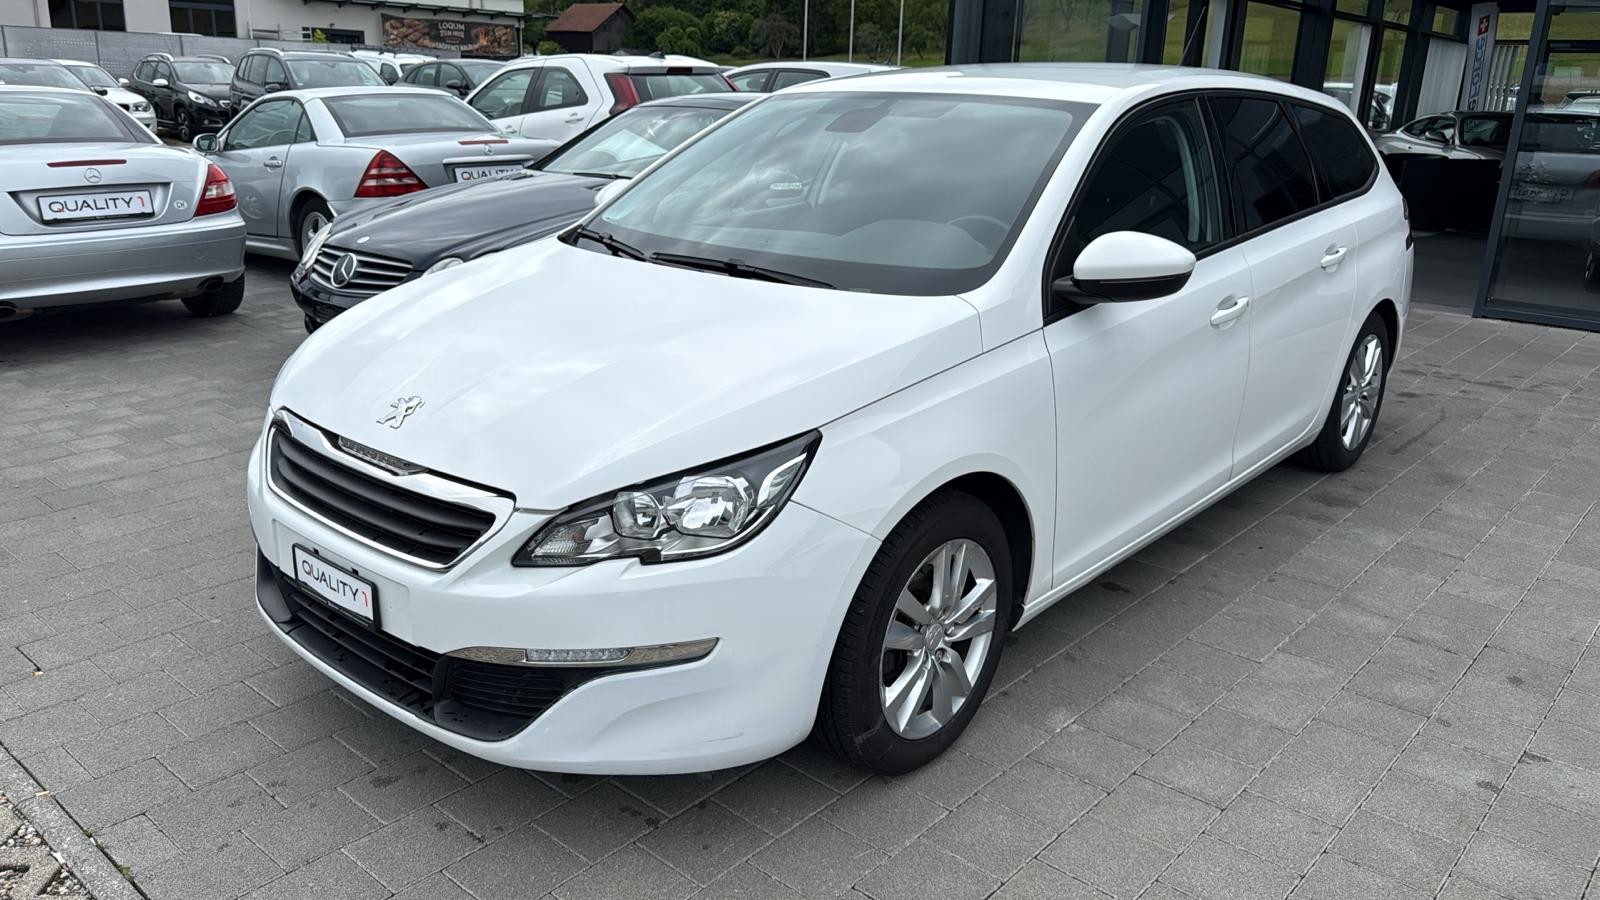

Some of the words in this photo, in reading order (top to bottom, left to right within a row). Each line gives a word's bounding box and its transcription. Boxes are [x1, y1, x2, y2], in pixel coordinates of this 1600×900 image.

[48, 197, 134, 213] QUALITY
[137, 196, 145, 208] 1
[302, 559, 359, 601] QUALITY
[361, 591, 369, 607] 1
